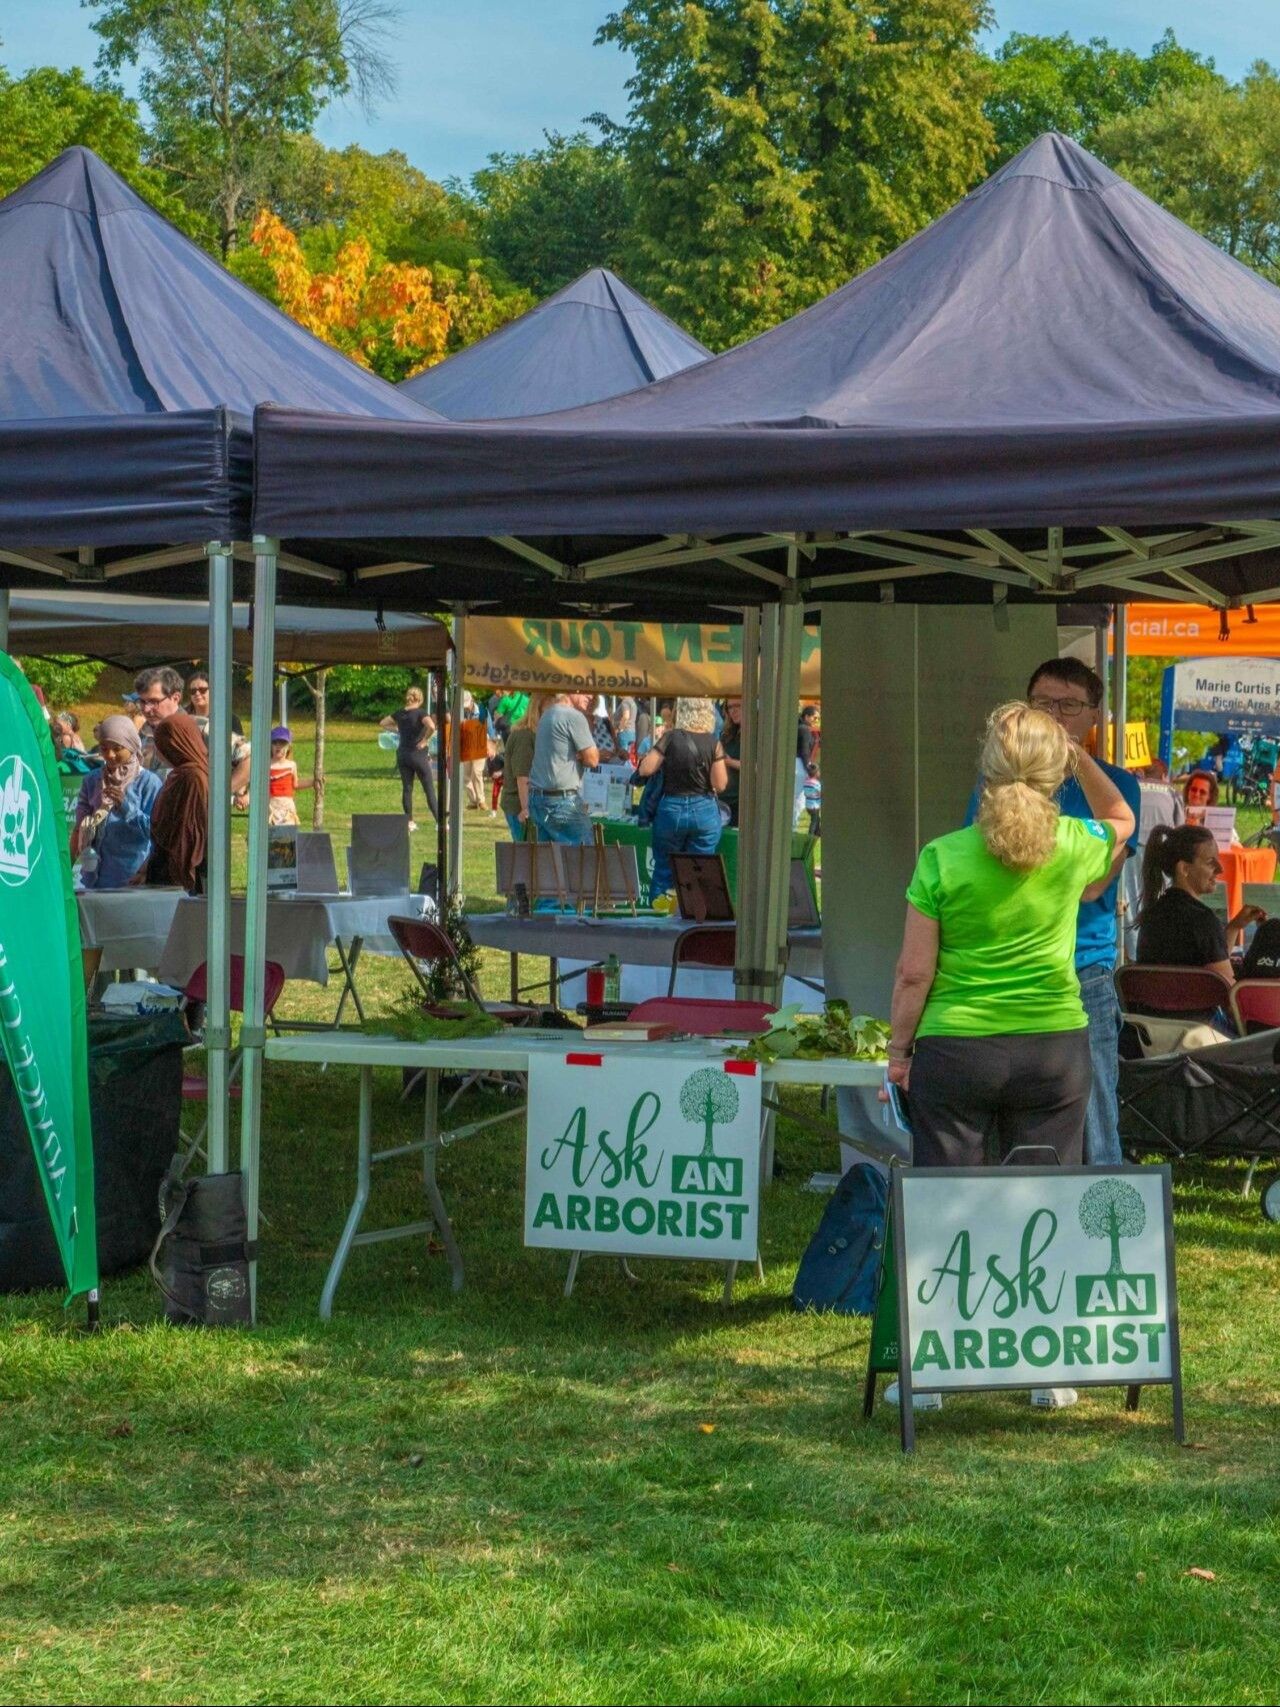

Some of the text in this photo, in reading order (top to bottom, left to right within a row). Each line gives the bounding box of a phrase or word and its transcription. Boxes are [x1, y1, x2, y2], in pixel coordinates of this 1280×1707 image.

[1126, 617, 1200, 637] cial.ca
[1195, 678, 1231, 692] Marie
[1235, 681, 1271, 695] Curtis
[1212, 696, 1280, 711] Picnic Area 2
[541, 1091, 734, 1192] Ask AN
[532, 1192, 749, 1240] ARBORIST
[917, 1208, 1147, 1321] Ask AN
[912, 1323, 1166, 1371] ARBORIST
